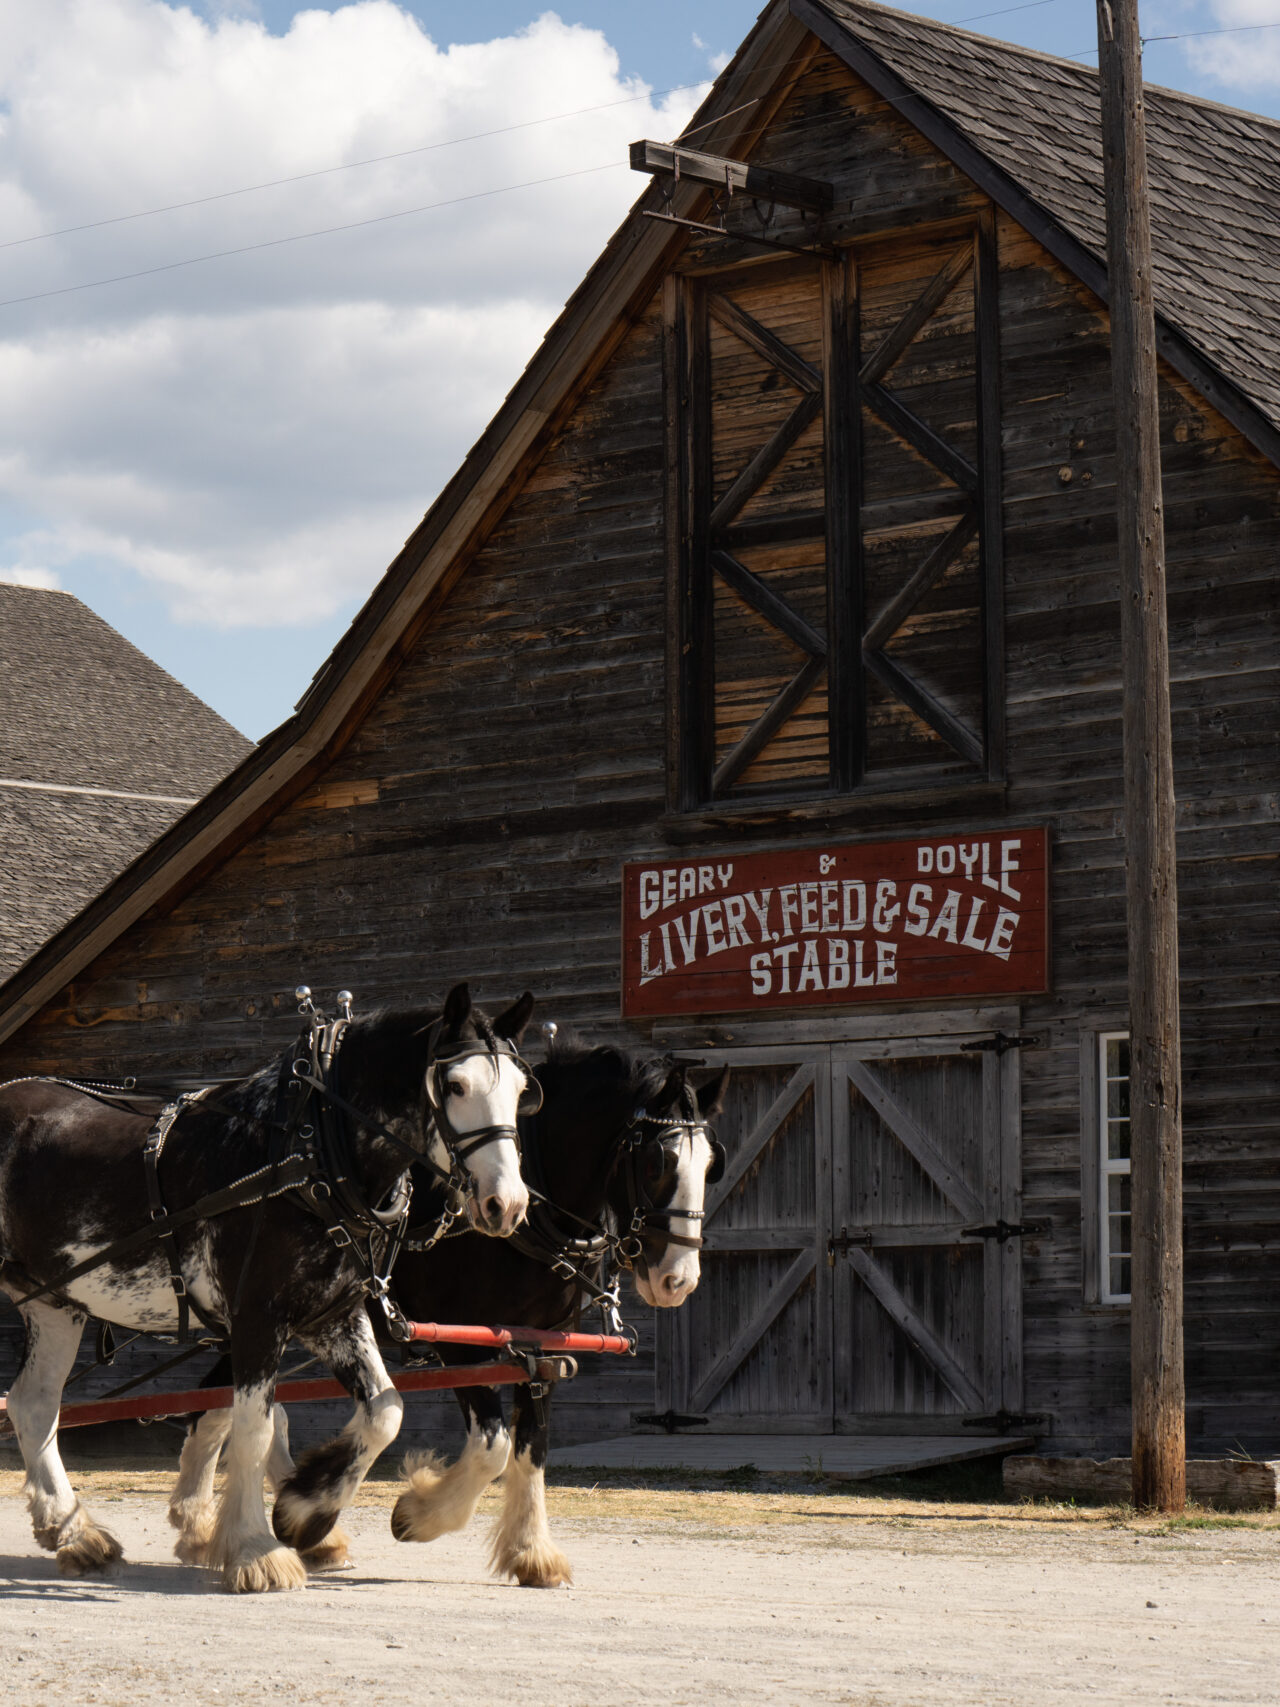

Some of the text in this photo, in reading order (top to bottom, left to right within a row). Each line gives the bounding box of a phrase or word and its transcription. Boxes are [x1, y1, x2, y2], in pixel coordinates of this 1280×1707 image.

[639, 839, 1021, 920] GEARY & DOYLE
[777, 879, 866, 935] FEED
[873, 879, 901, 933] &
[904, 883, 1020, 962] SALE
[750, 938, 898, 995] STABLE
